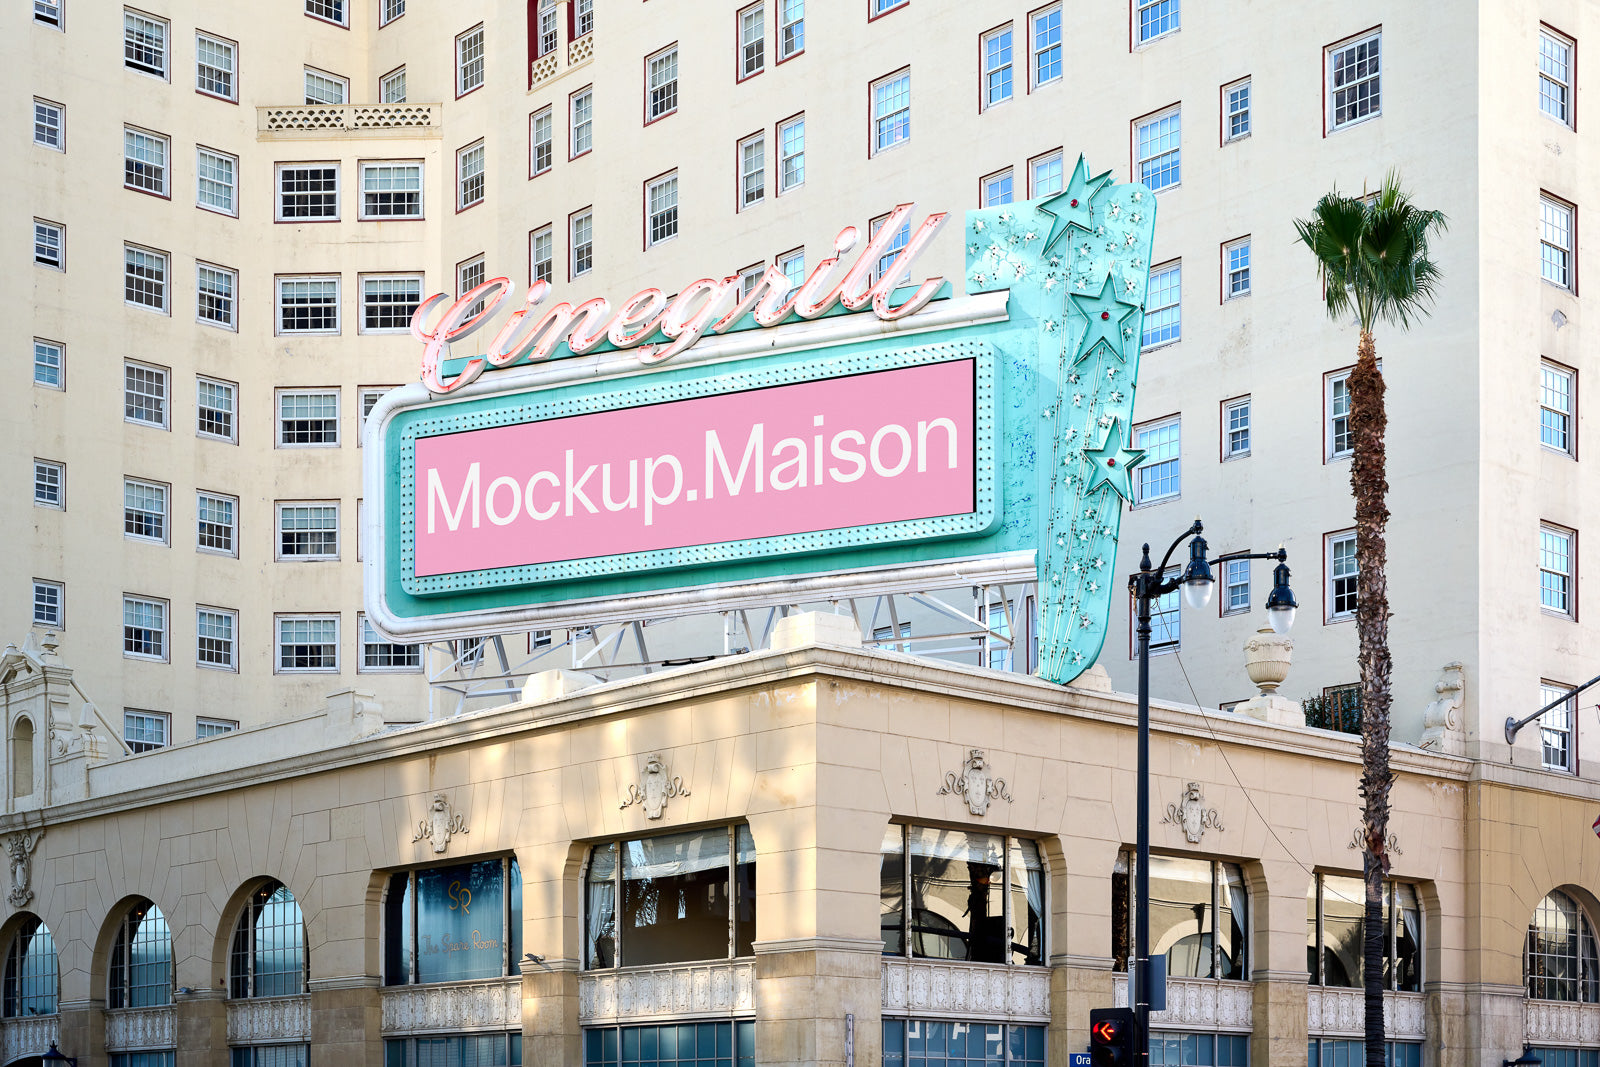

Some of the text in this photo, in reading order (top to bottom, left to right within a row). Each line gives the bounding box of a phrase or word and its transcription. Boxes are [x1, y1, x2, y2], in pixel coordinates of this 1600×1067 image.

[409, 202, 951, 395] Cinegrill
[427, 415, 959, 534] Mockup.Maison
[448, 880, 472, 916] SR
[422, 929, 499, 960] The Spare Room
